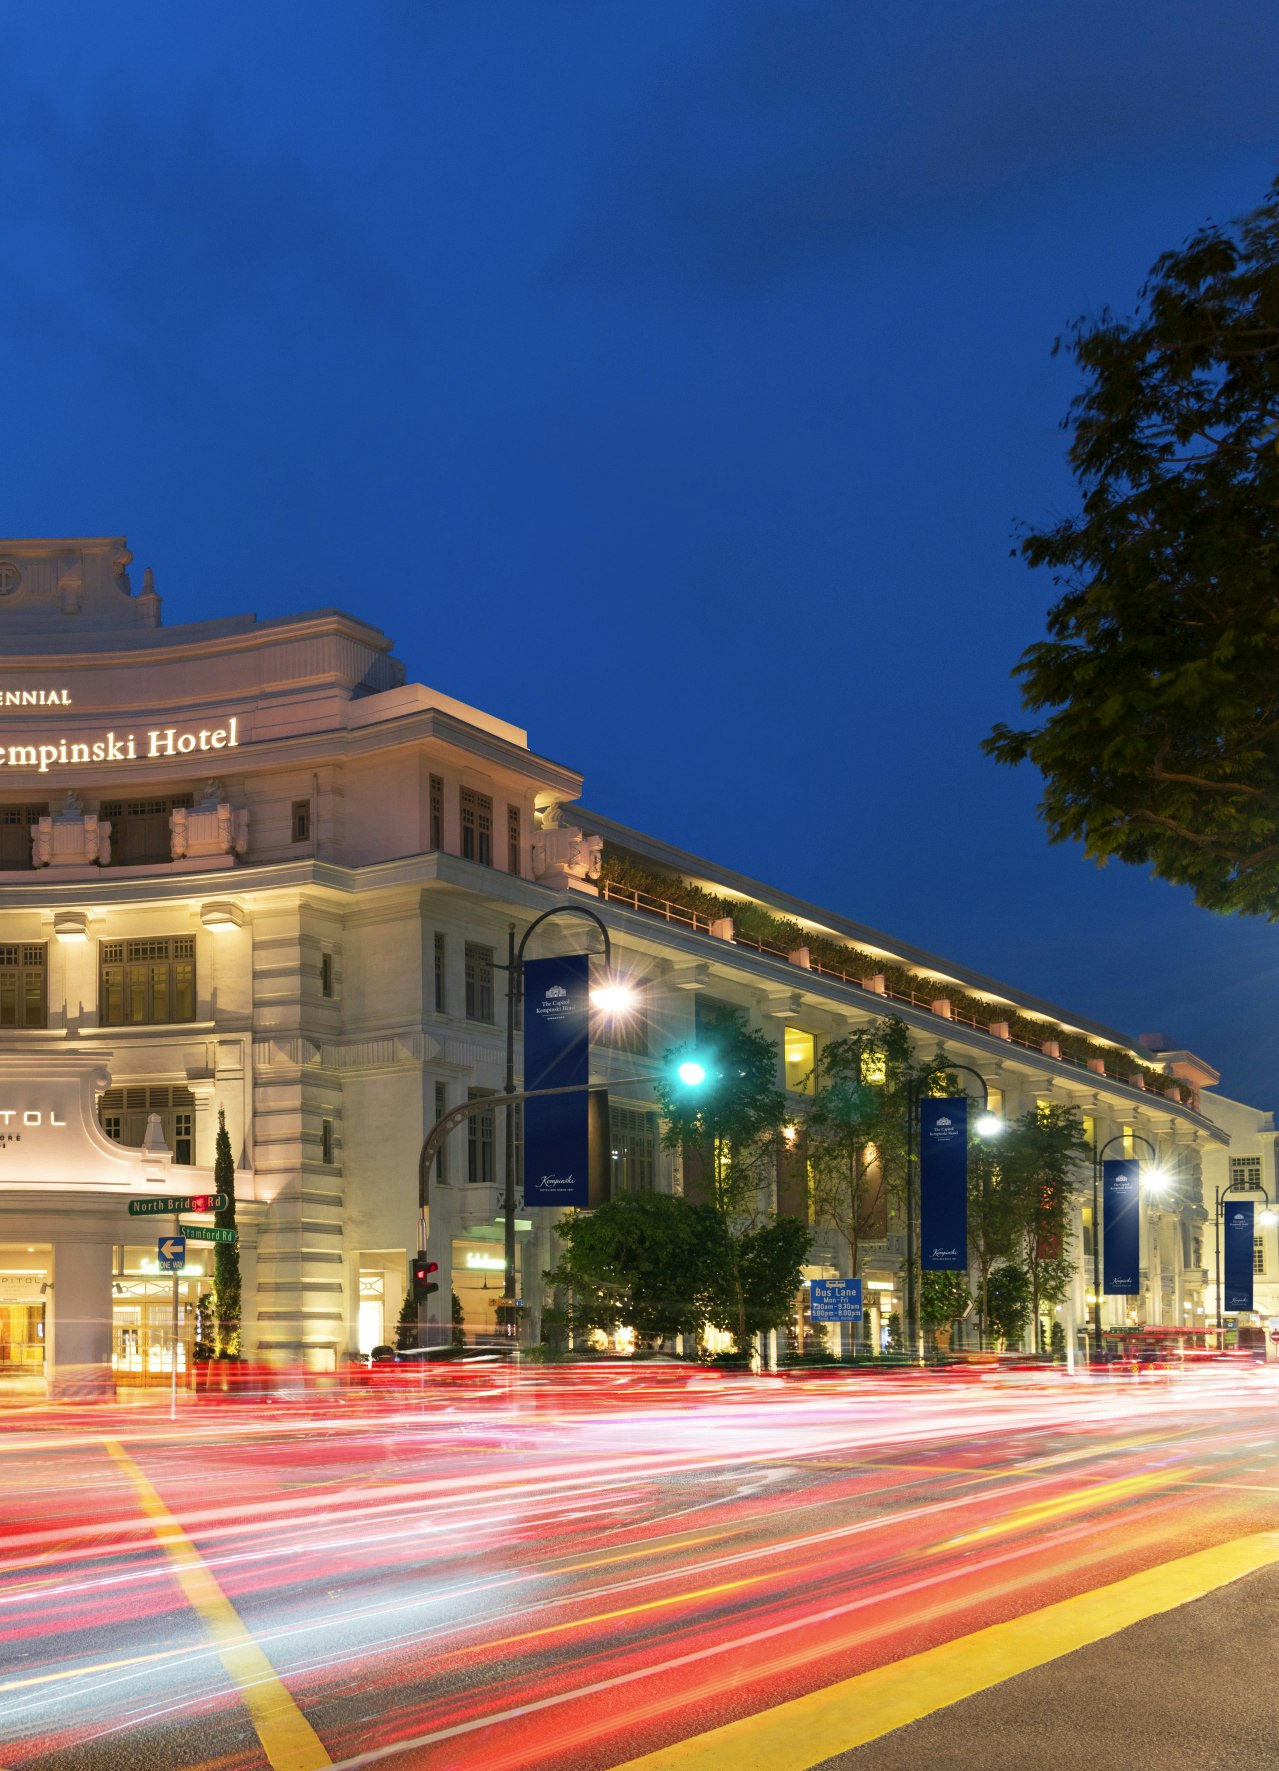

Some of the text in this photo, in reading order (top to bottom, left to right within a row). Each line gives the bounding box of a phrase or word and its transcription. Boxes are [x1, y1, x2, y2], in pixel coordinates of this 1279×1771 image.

[147, 717, 239, 758] Hotel
[535, 1174, 576, 1188] Kempinski
[133, 1201, 164, 1212] North
[208, 1196, 221, 1207] Rd
[181, 1226, 232, 1242] Stamford Rd
[160, 1260, 171, 1269] ONE
[172, 1260, 184, 1269] WAY
[815, 1288, 856, 1296] Bus Lane
